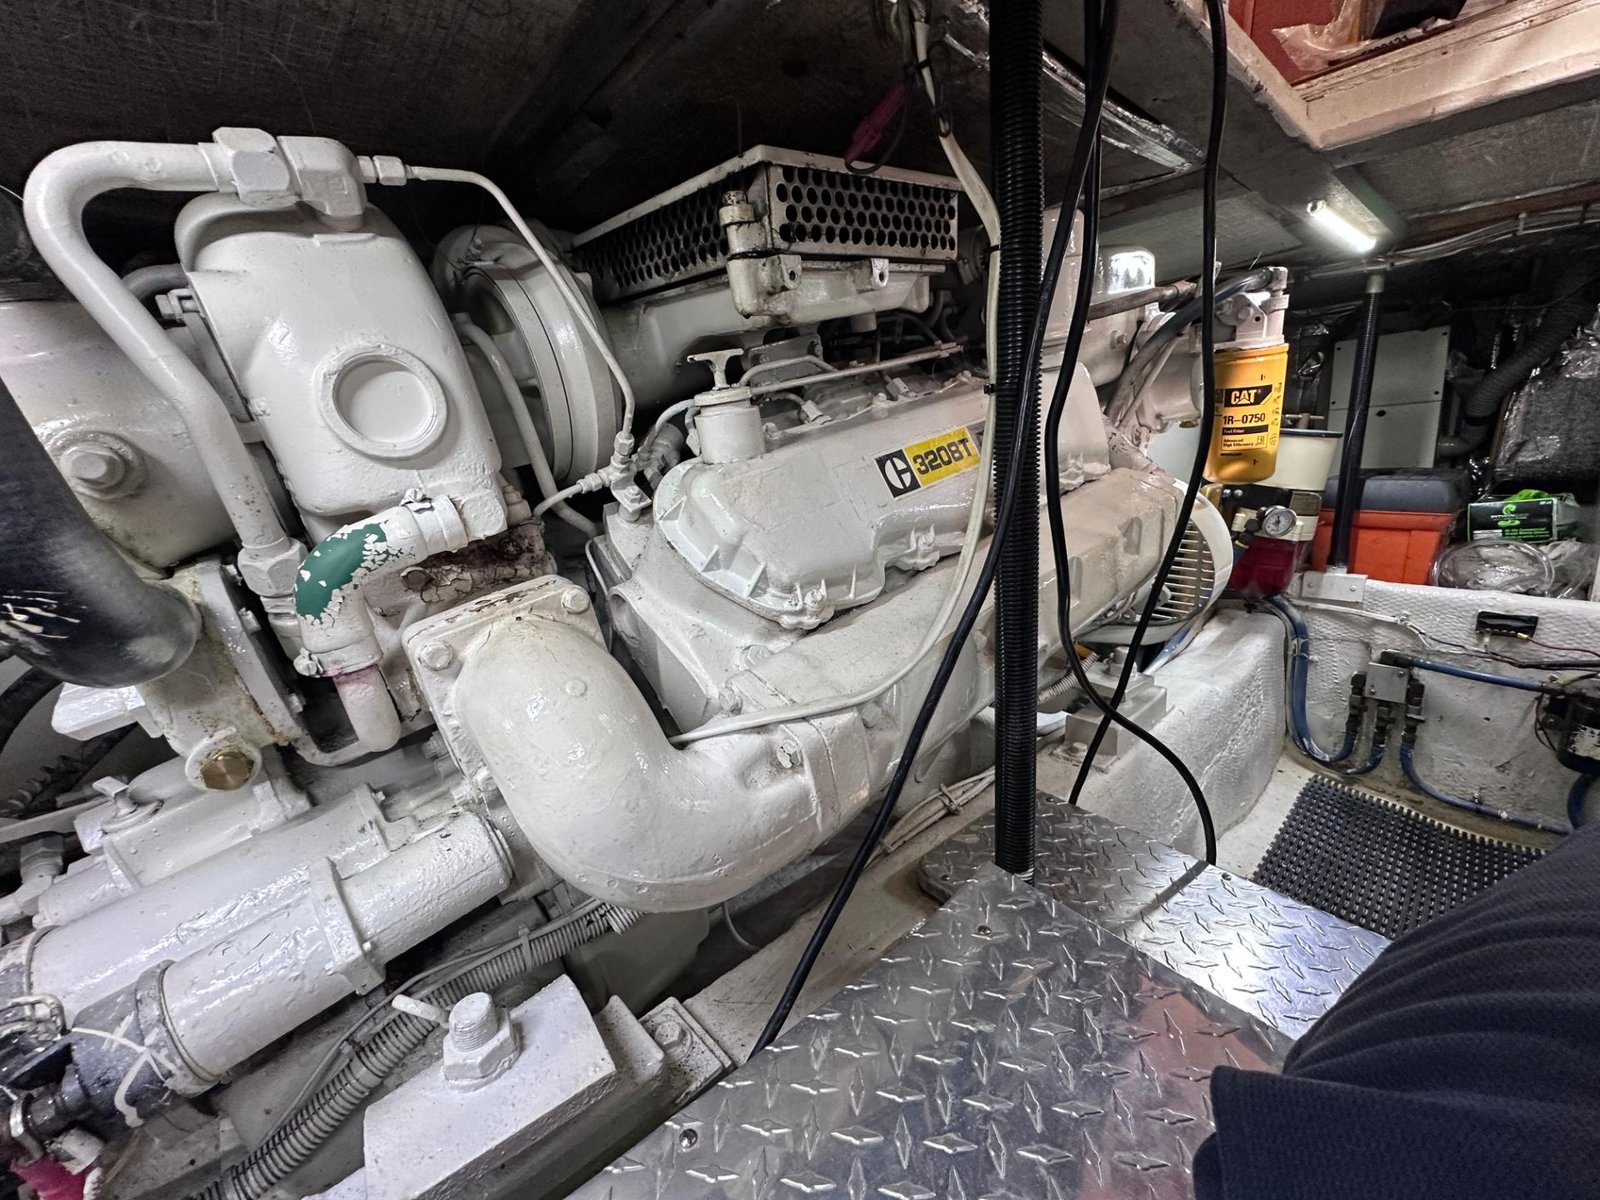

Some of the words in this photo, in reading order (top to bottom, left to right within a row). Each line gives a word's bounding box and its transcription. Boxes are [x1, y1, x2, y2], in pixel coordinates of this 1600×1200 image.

[1231, 390, 1257, 405] CAT
[1223, 413, 1266, 425] 1R-0750
[913, 438, 971, 475] 3208T
